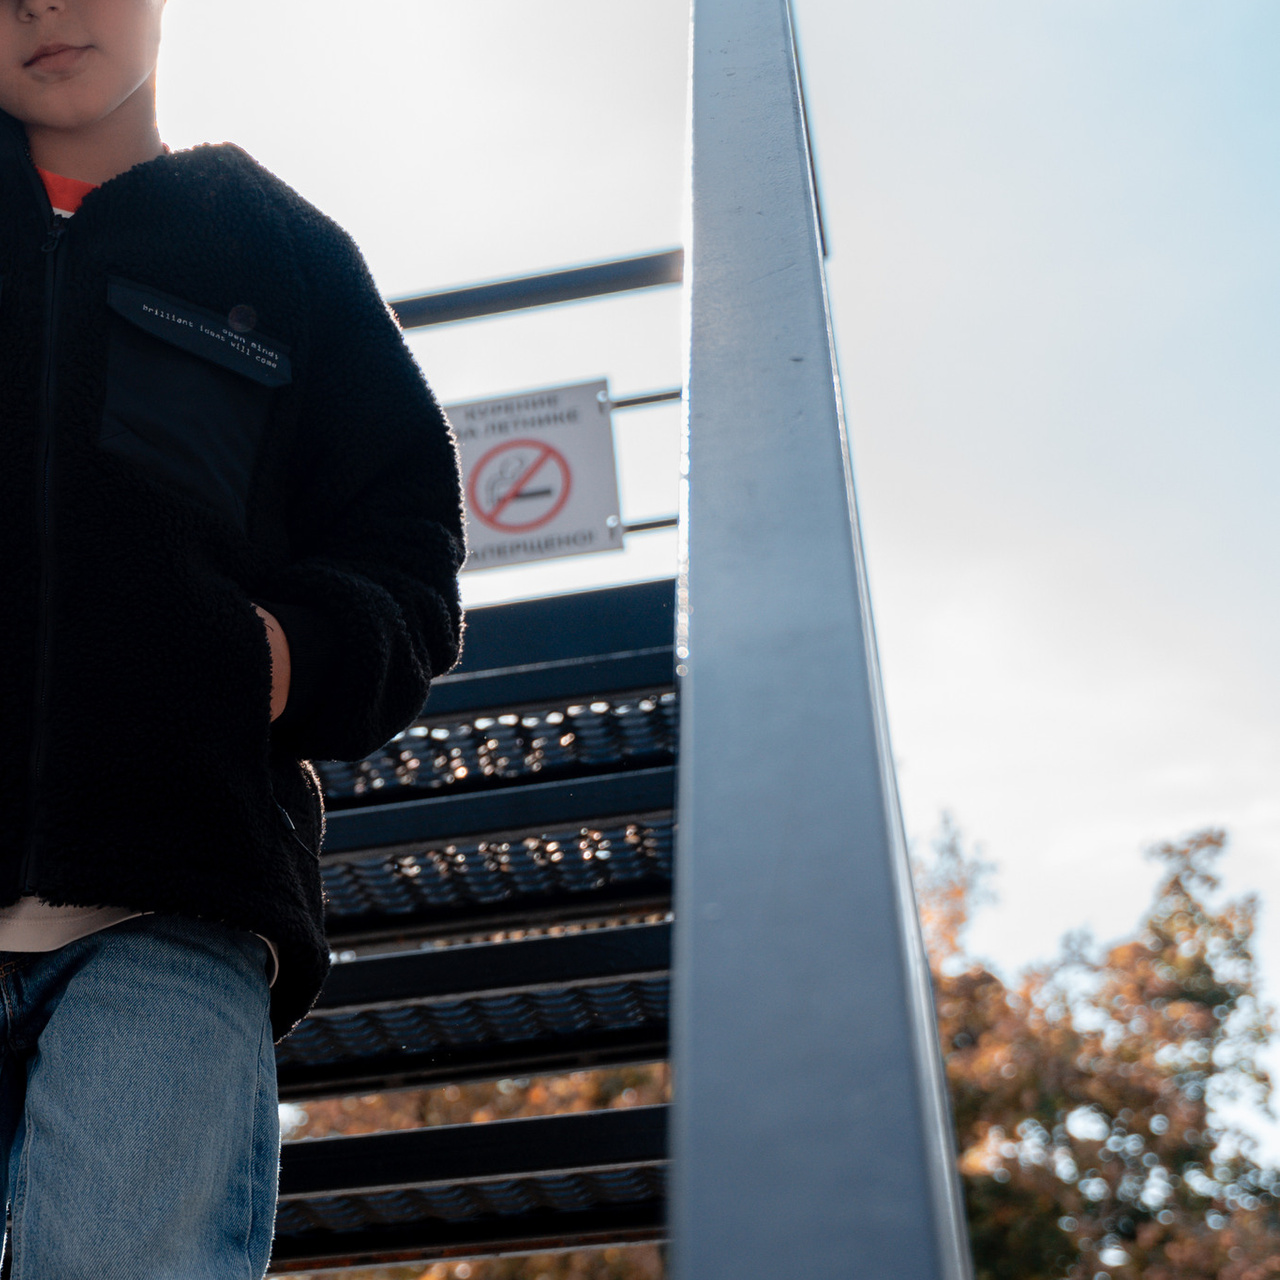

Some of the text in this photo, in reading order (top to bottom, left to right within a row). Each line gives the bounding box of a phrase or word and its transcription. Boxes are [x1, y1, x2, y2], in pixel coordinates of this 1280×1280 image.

[142, 304, 277, 369] brilliant ideas will come
[222, 329, 279, 360] open minds
